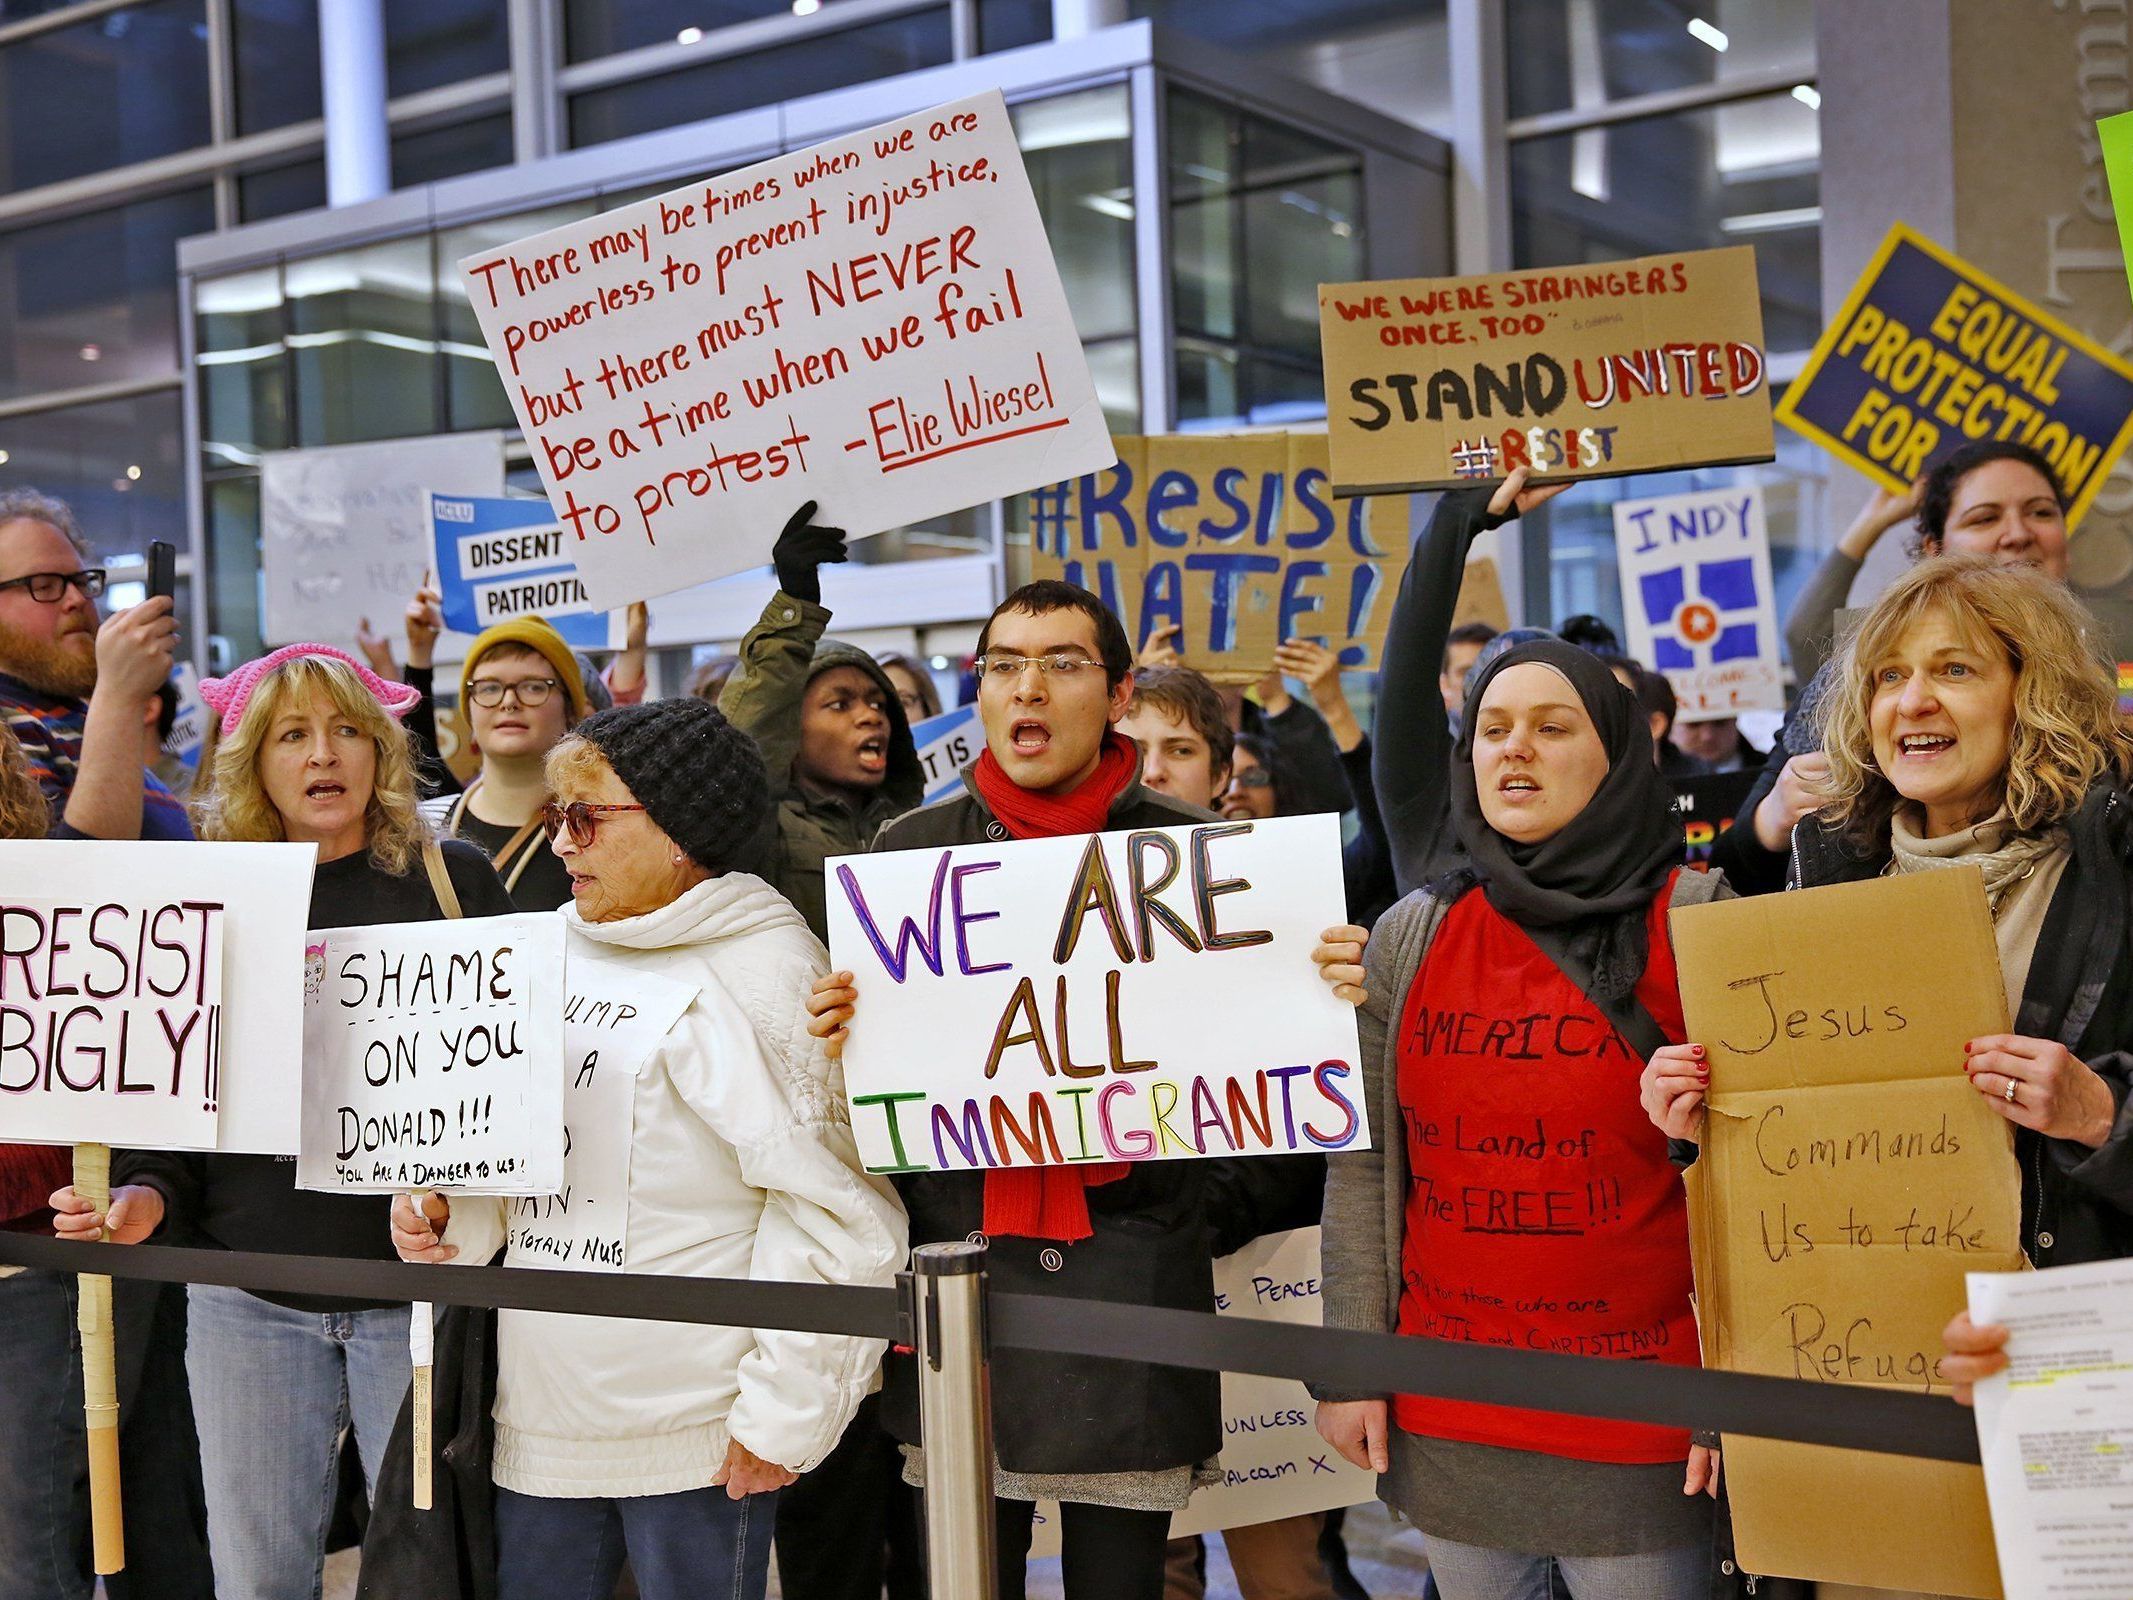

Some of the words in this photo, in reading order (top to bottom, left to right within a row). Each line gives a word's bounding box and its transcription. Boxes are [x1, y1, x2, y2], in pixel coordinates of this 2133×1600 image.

[469, 248, 581, 308] There
[589, 224, 649, 263] may
[660, 202, 696, 235] be
[703, 178, 781, 223] times
[794, 152, 860, 188] when
[874, 129, 914, 158] we
[929, 112, 978, 141] are
[503, 279, 655, 376] powerless
[660, 255, 701, 292] to
[715, 198, 827, 295] prevent
[1400, 284, 1494, 317] WERE
[1502, 262, 1688, 308] STRANGERS
[520, 368, 585, 427] but
[595, 344, 691, 400] there
[697, 284, 783, 360] must
[806, 225, 981, 317] NEVER
[1929, 281, 2070, 406] EQUAL
[541, 436, 601, 481] be
[608, 428, 641, 458] a
[638, 391, 731, 447] time
[742, 347, 849, 408] when
[861, 315, 924, 362] we
[934, 268, 1023, 339] fail
[1349, 352, 1568, 431] STAND
[1573, 341, 1765, 410] UNITED
[1836, 303, 2101, 498] PROTECTION
[561, 491, 620, 541] to
[634, 414, 810, 546] protest
[945, 351, 1054, 437] Wiesel
[1450, 425, 1618, 478] #RESIST
[1842, 387, 1940, 481] FOR
[470, 531, 563, 569] DISSENT
[1628, 497, 1751, 553] INDY
[946, 737, 970, 767] IS
[836, 850, 1013, 984] WE
[1053, 823, 1274, 964] ARE
[0, 901, 224, 1006] RESIST
[340, 947, 513, 1008] SHAME
[564, 995, 637, 1029] UMP
[984, 969, 1159, 1079] ALL
[1407, 1006, 1631, 1061] AMERICA
[1720, 970, 1908, 1055] Jesus
[0, 1004, 221, 1113] BIGLY!!
[364, 1031, 419, 1087] ON
[440, 1020, 523, 1073] YOU
[574, 1050, 599, 1089] A
[852, 1059, 1360, 1174] IMMIGRANTS
[1402, 1106, 1442, 1148] The
[1455, 1115, 1546, 1160] Land
[1556, 1129, 1597, 1159] of
[1755, 1104, 1962, 1177] Commands
[336, 1164, 363, 1185] YOU
[372, 1161, 392, 1182] ARE
[398, 1162, 408, 1182] A
[413, 1161, 473, 1186] DANGER
[475, 1160, 489, 1179] TO
[1412, 1175, 1454, 1222] The
[1760, 1203, 1815, 1262] Us
[1838, 1207, 1873, 1248] to
[1894, 1206, 1987, 1252] take
[1252, 1276, 1321, 1304] PEACE
[1460, 1286, 1508, 1310] those
[1515, 1298, 1557, 1313] who
[1567, 1299, 1610, 1314] are
[1488, 1327, 1514, 1347] and
[1225, 1409, 1308, 1434] UNLESS
[1307, 1454, 1336, 1475] X
